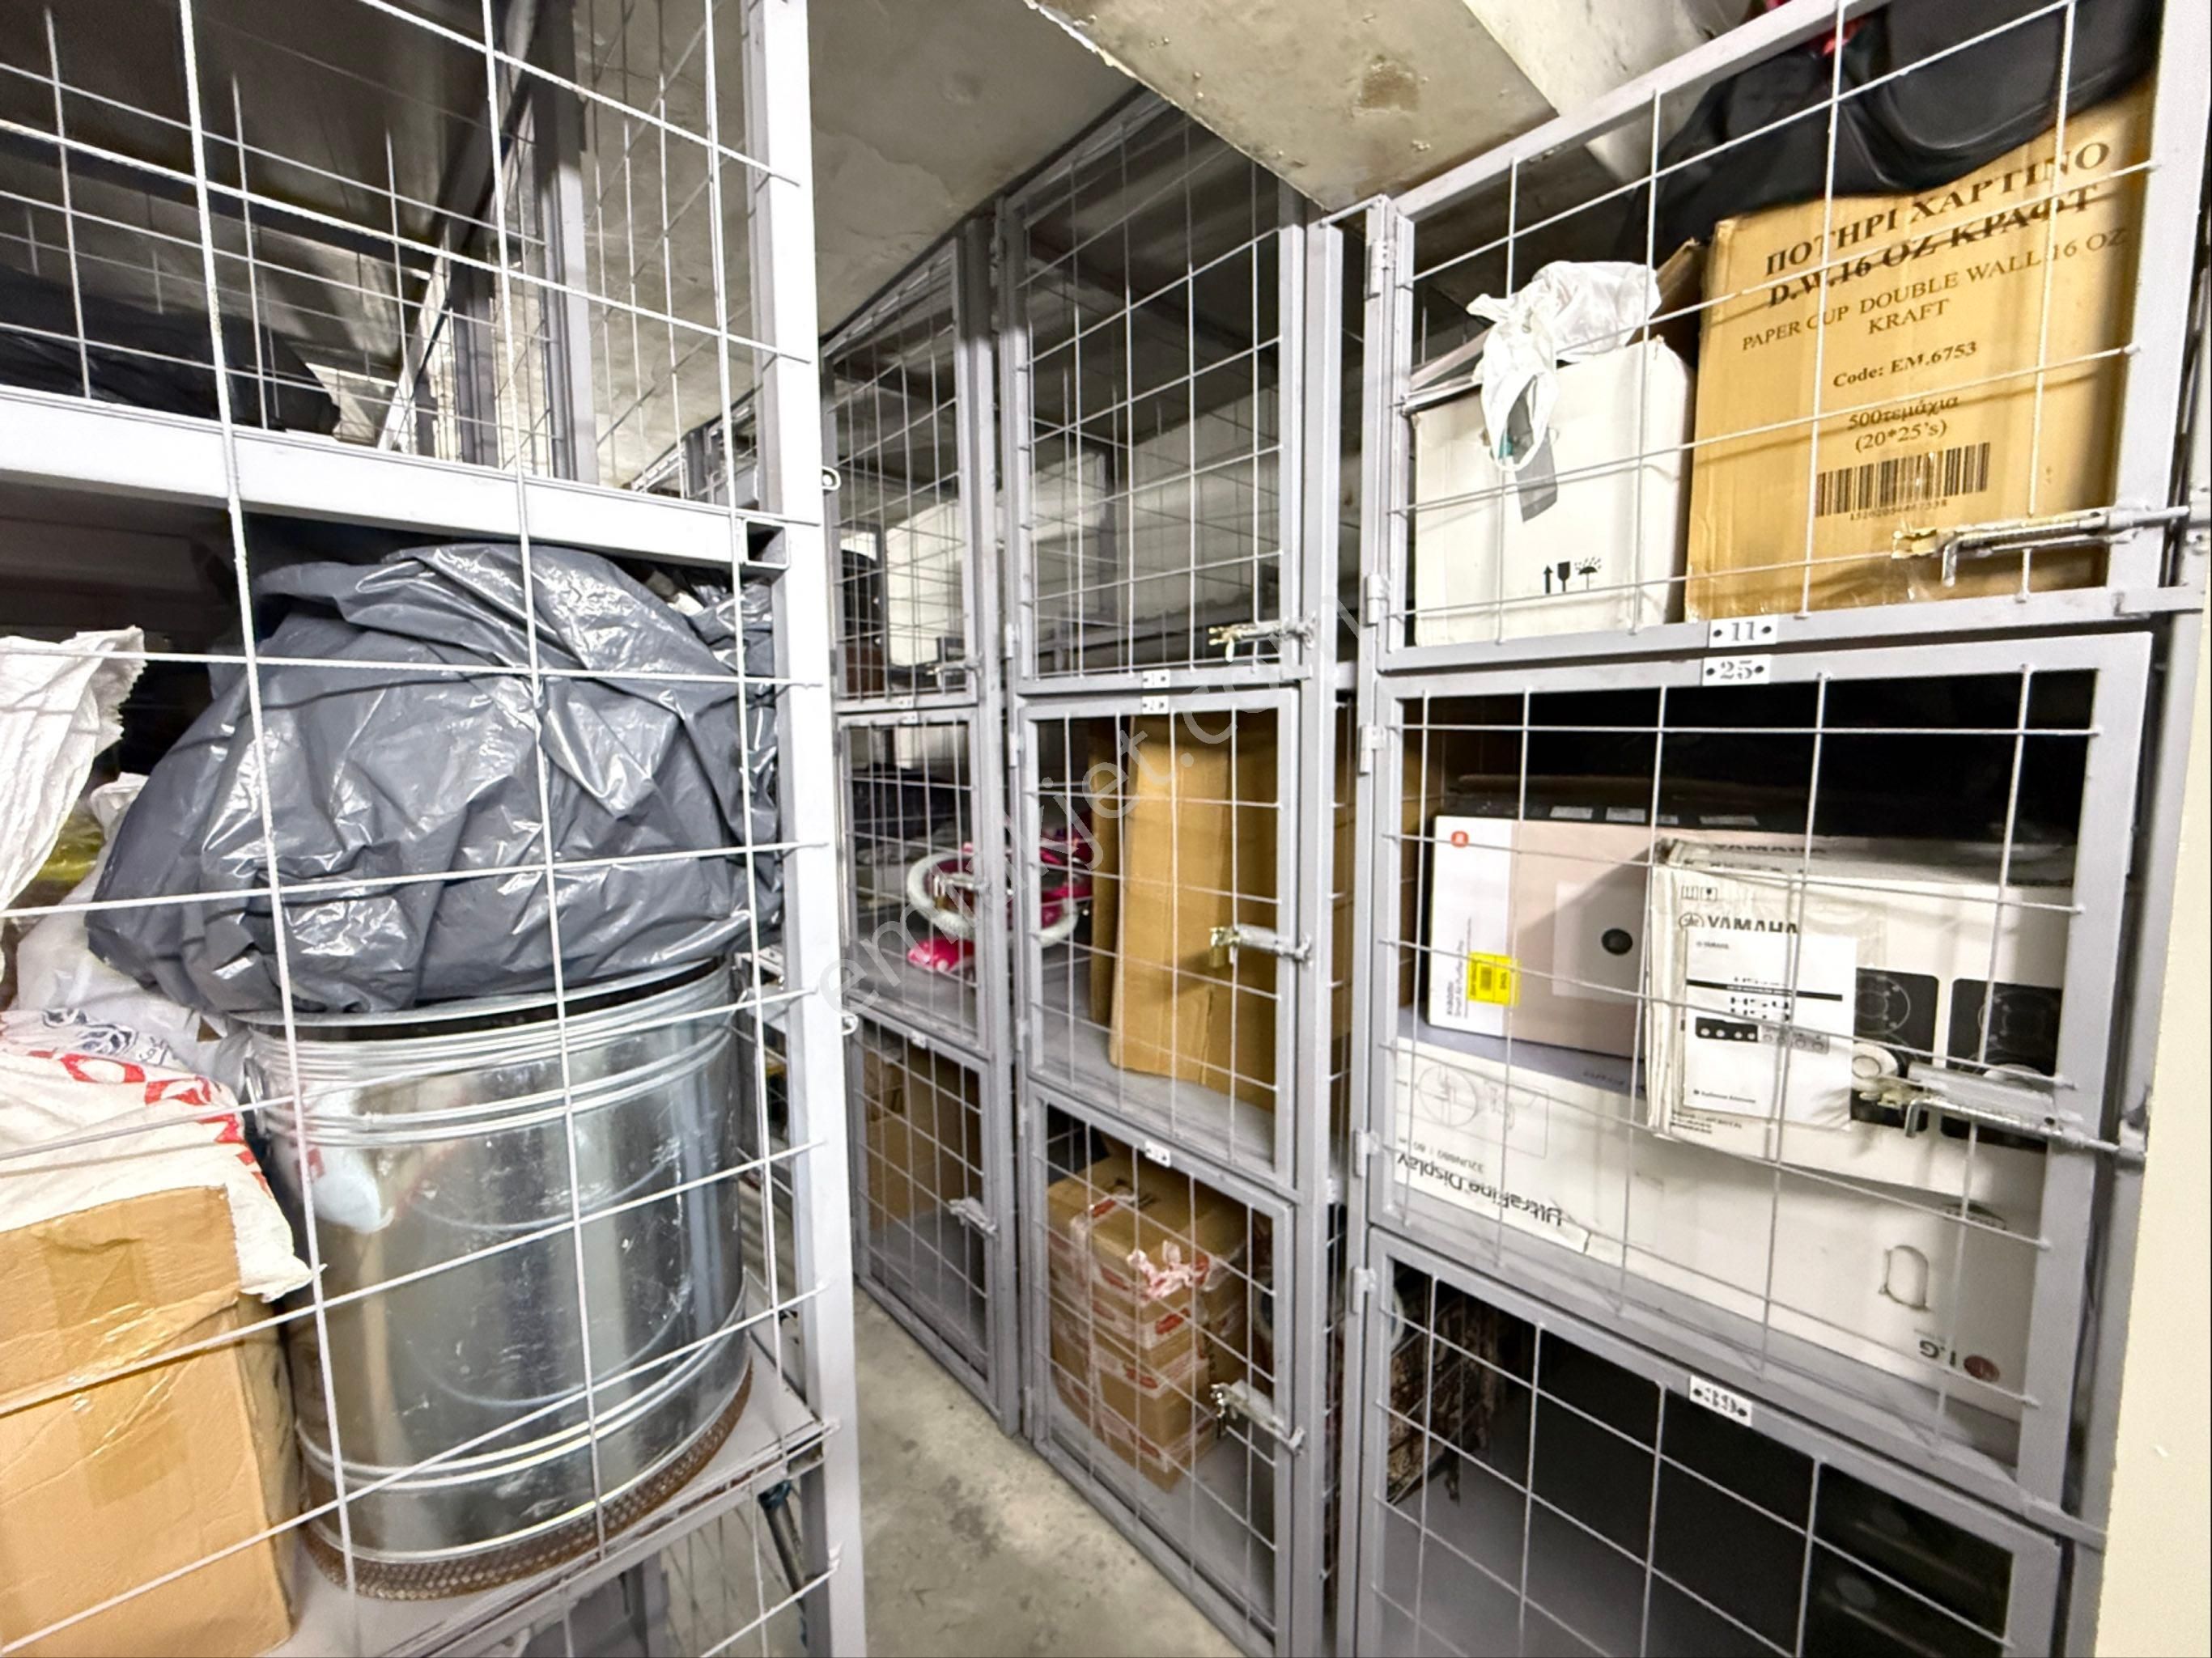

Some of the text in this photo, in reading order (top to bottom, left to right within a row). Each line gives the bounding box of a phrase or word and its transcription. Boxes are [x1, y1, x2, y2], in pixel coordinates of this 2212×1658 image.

[1766, 142, 2110, 276] ΠΟΤΗΡΙ ΧΑΡΤΙΝΟ
[1882, 235, 1938, 268] OZ
[1741, 227, 2126, 350] PAPER CUP DOUBLE WALL 16 OZ
[1867, 299, 1951, 336] KRAFT
[1833, 341, 1977, 388] Code: EM.6753
[1731, 621, 1755, 642] 11
[1719, 659, 1753, 680] 25
[1707, 914, 1800, 935] YAMAHA
[1397, 1152, 1563, 1227] UltraFine Display
